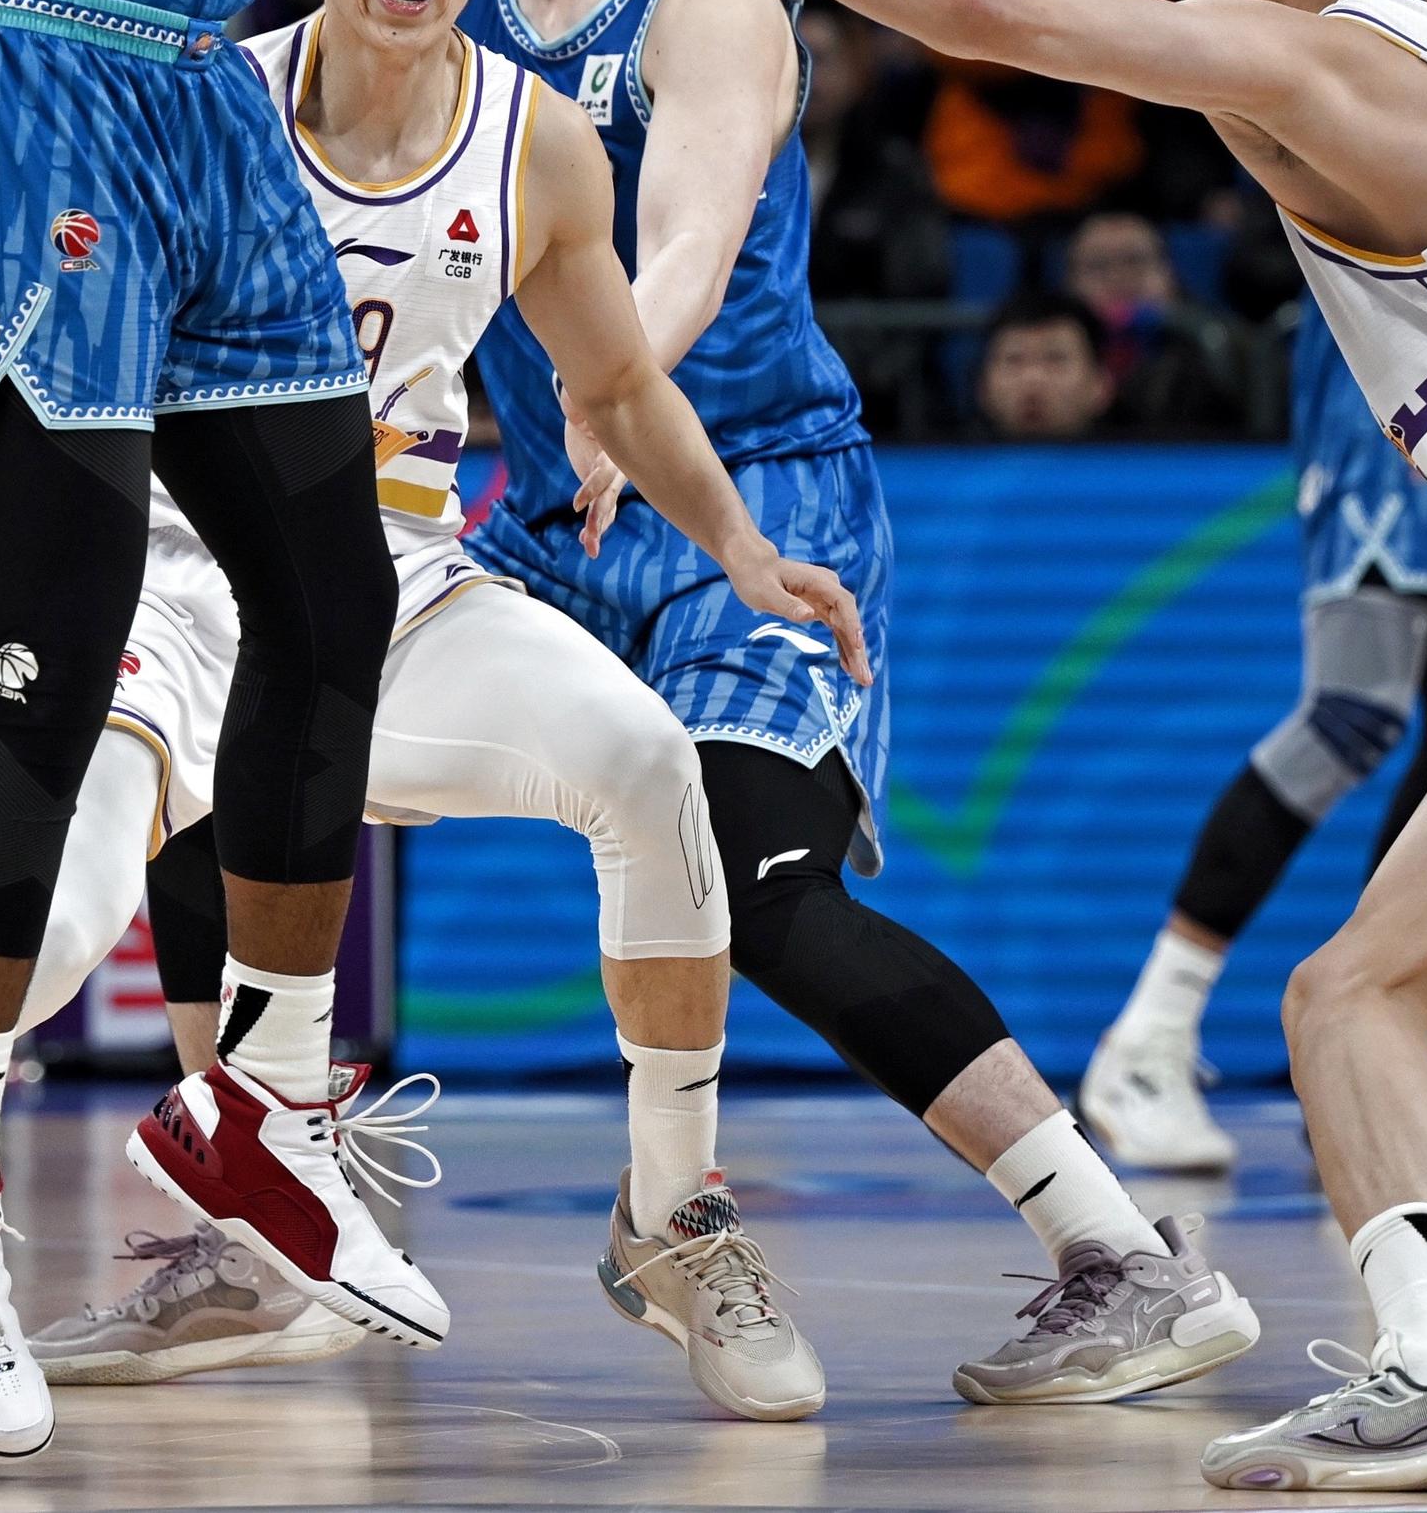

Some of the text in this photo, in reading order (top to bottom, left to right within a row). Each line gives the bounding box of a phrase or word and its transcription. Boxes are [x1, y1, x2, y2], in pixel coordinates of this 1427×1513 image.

[438, 248, 483, 266] 广发银行
[59, 259, 100, 272] CBA
[445, 264, 472, 279] CGB
